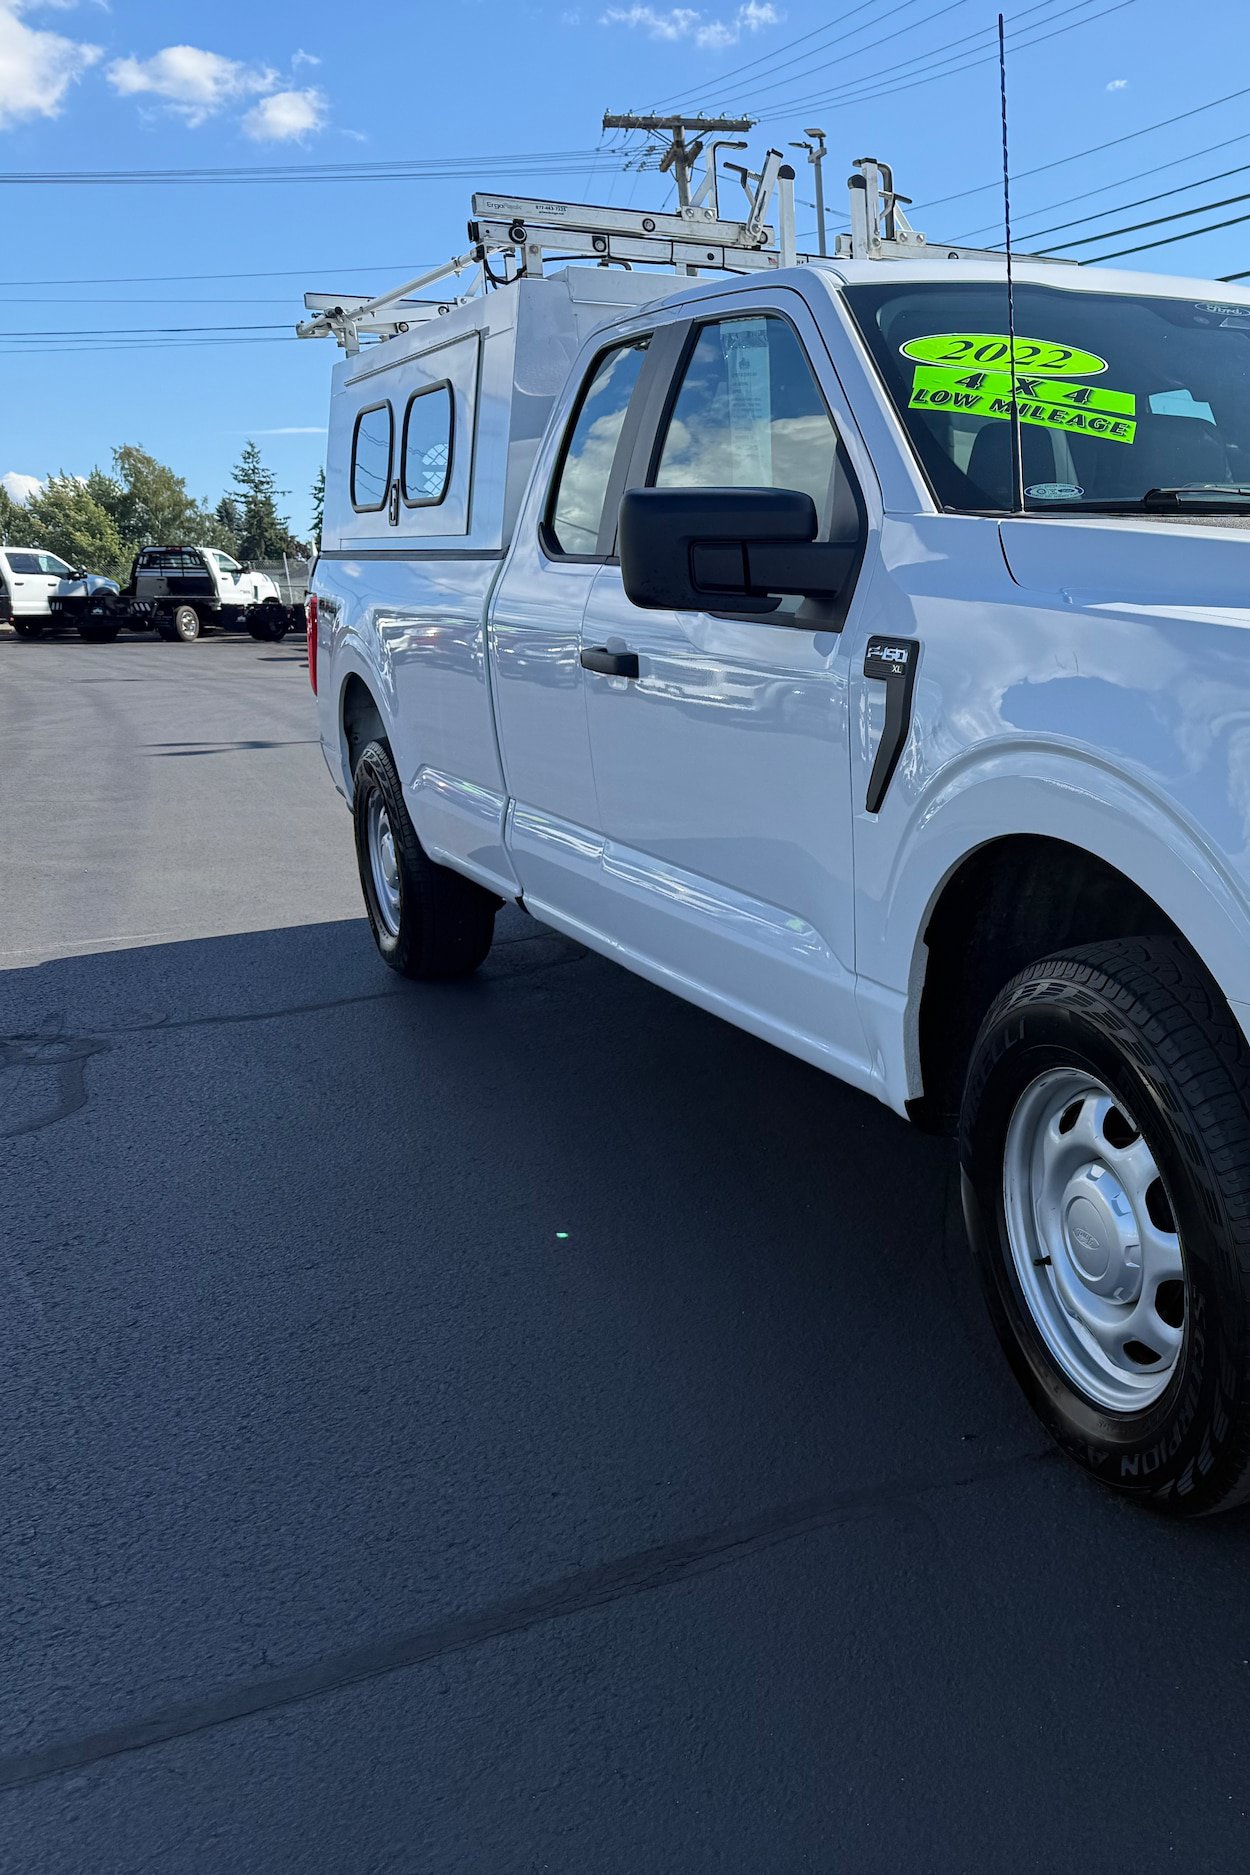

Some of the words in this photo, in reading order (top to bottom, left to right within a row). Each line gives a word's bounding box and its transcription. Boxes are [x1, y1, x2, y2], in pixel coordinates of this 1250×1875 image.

[935, 340, 1073, 369] 2022
[954, 372, 988, 390] 4
[1008, 377, 1046, 398] X
[1063, 388, 1095, 405] 4
[913, 388, 984, 408] LOW
[989, 398, 1134, 437] MILEAGE
[891, 664, 902, 674] XL
